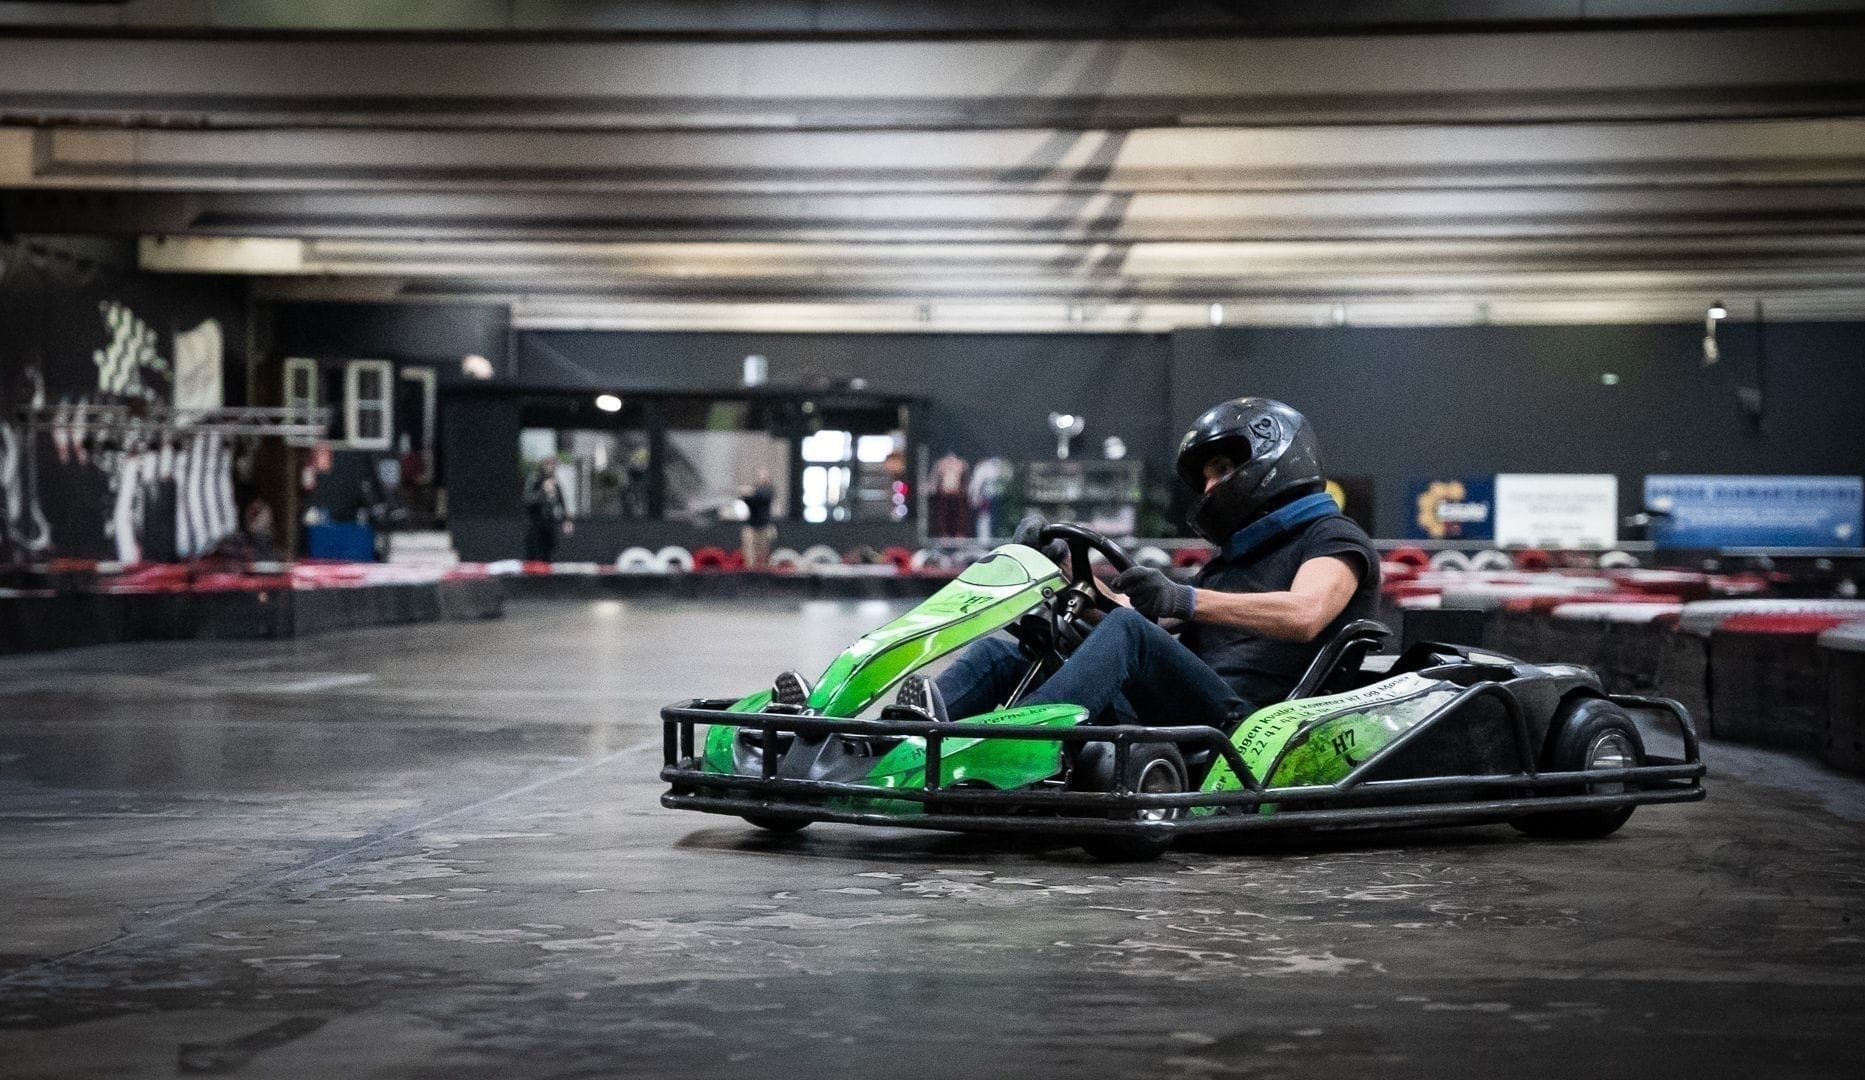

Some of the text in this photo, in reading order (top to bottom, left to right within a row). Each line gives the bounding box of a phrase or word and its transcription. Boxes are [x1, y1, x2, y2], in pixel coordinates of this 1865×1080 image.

[1250, 740, 1268, 757] 22
[1264, 725, 1283, 738] 41
[1331, 729, 1355, 756] H7
